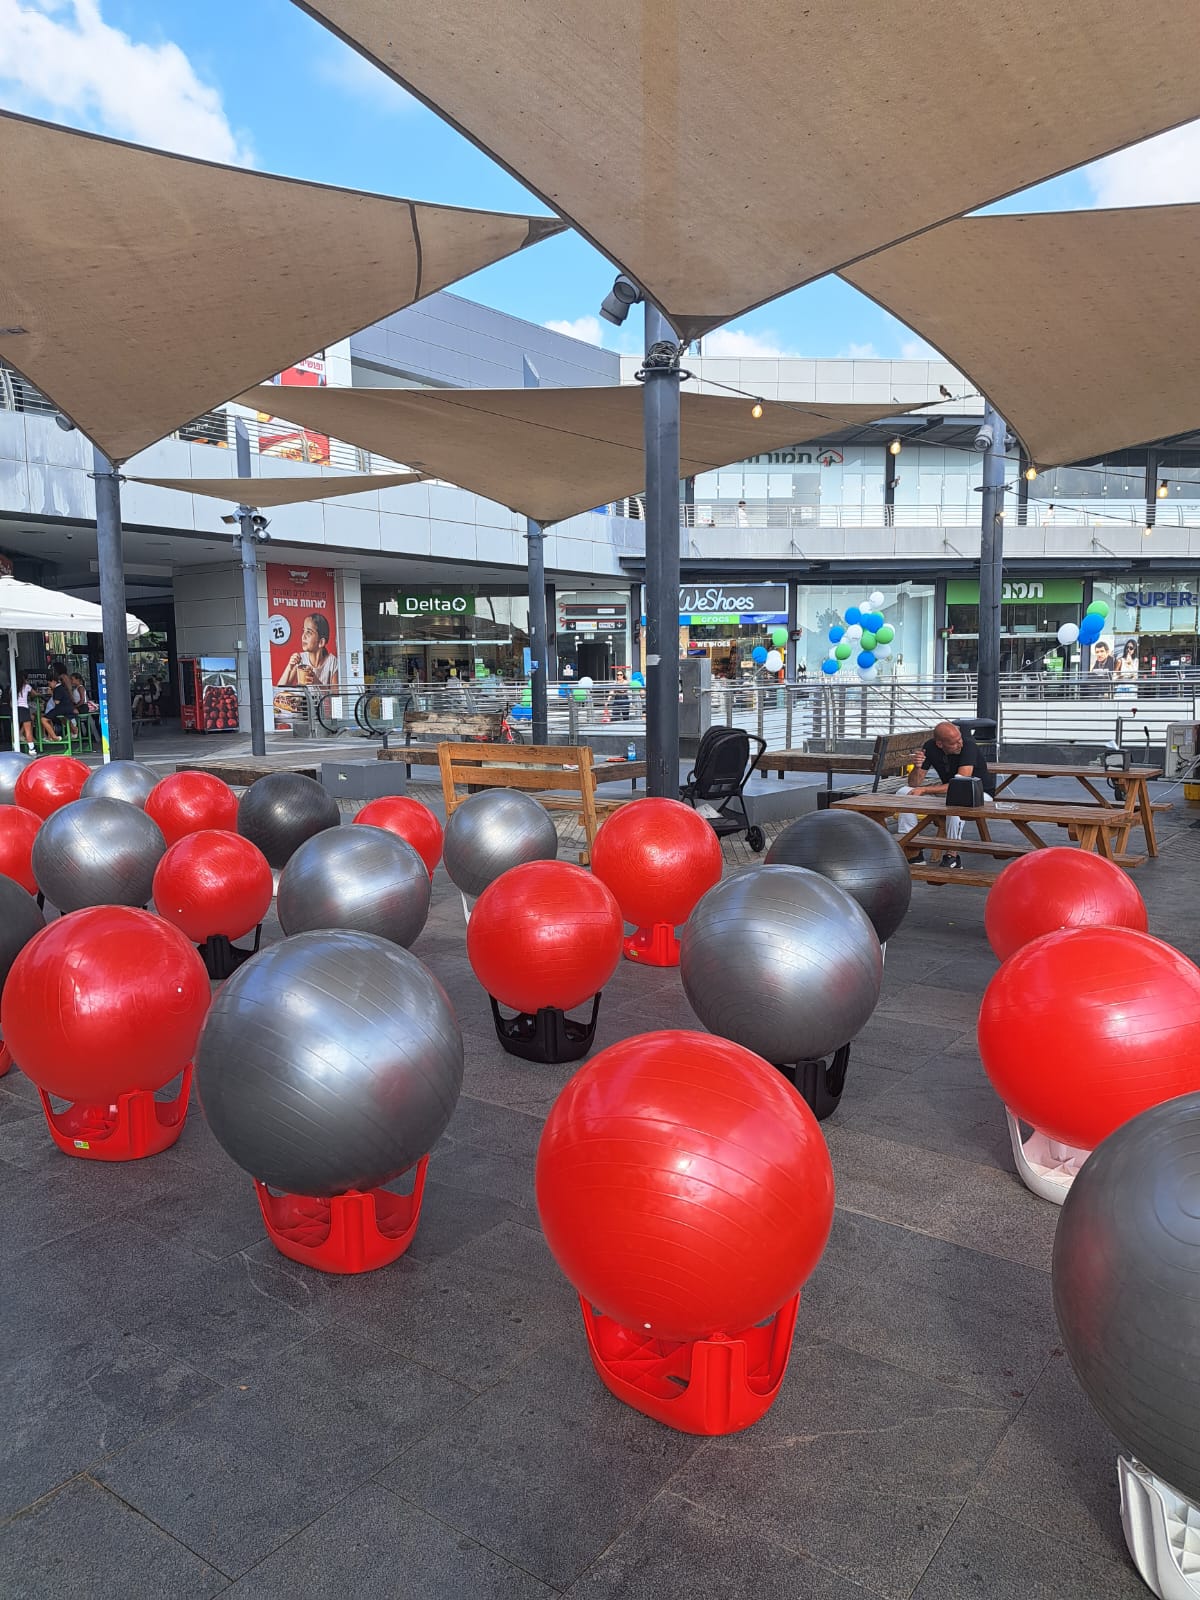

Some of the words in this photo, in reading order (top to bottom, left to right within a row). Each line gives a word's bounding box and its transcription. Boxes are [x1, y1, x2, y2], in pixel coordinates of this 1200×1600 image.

[1002, 582, 1044, 599] תמנ
[273, 597, 299, 607] צהריים
[300, 598, 327, 609] לארוחת
[406, 597, 451, 611] Delta
[679, 588, 754, 611] WeShoes
[701, 615, 730, 623] crocs
[273, 627, 285, 639] 25
